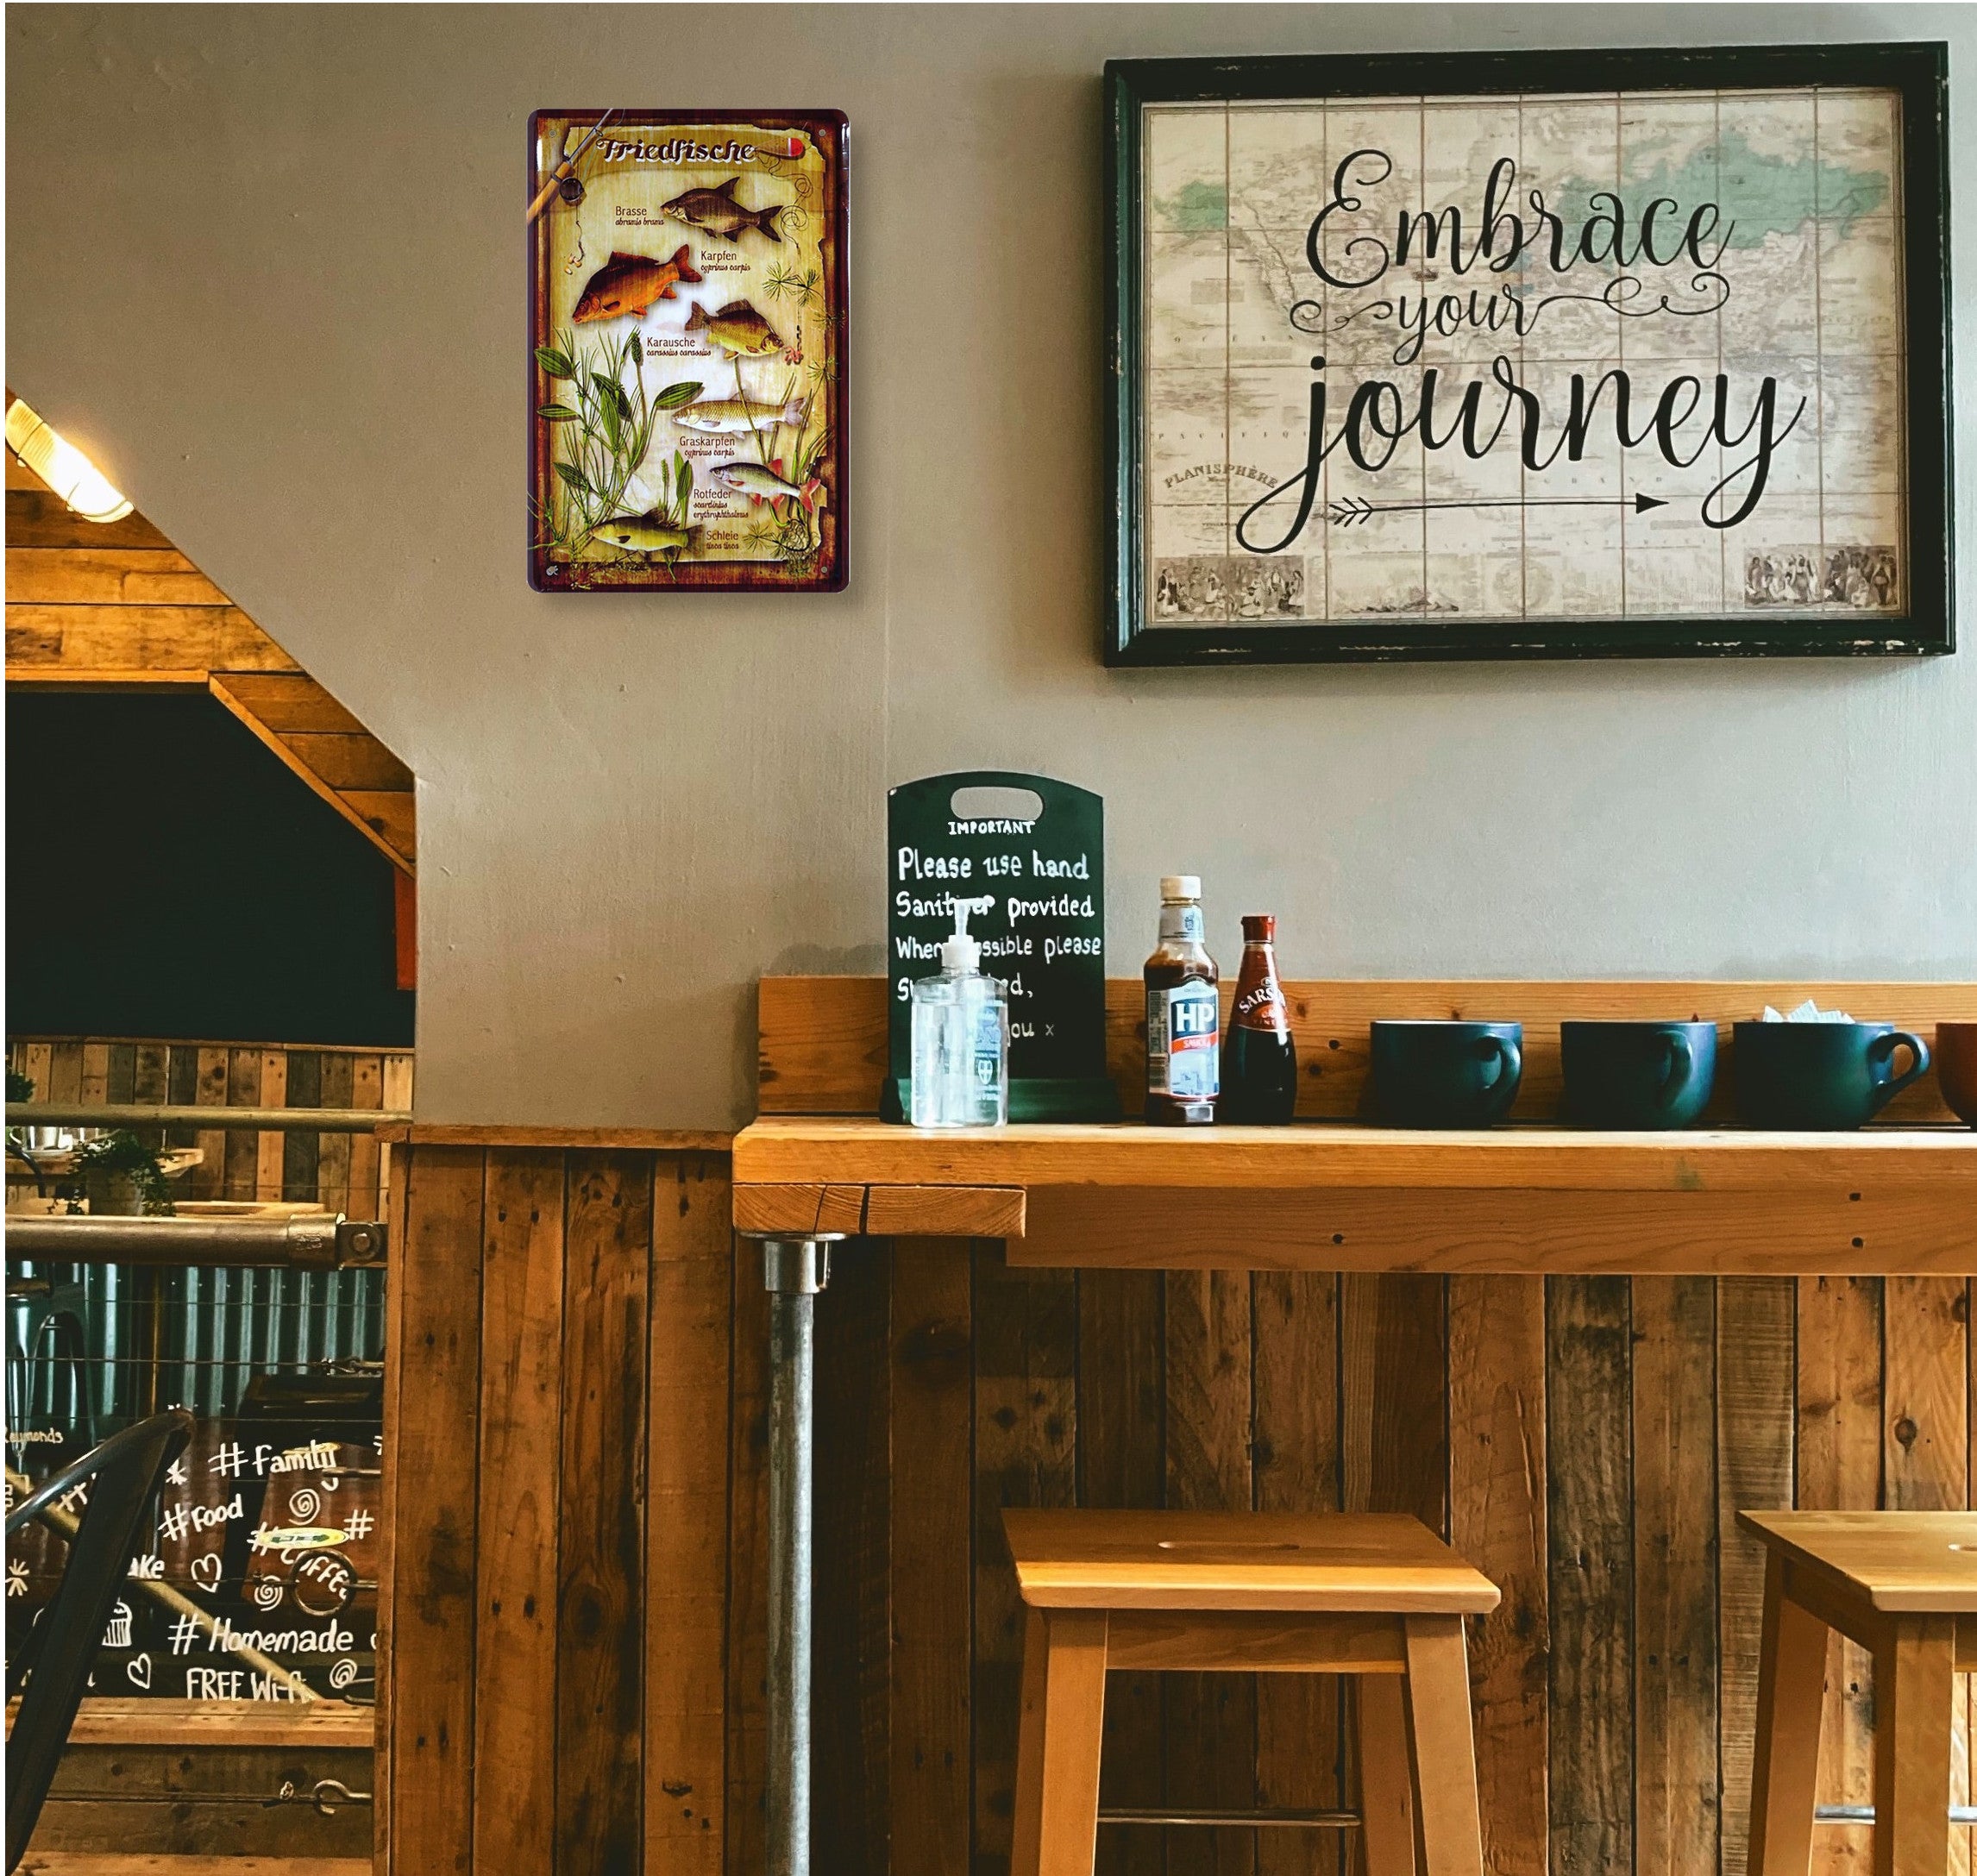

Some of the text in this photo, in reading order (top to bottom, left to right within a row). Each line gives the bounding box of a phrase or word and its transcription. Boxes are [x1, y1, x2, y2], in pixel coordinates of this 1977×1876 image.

[596, 138, 756, 164] Friedfische
[615, 205, 647, 216] Brasse
[1305, 148, 1735, 288] Embrace
[700, 250, 737, 263] Karpfen
[646, 336, 695, 347] Karausche
[679, 436, 735, 449] Graskarpfen
[1236, 354, 1808, 554] journey
[1164, 463, 1279, 489] PLANISPHÈRE
[694, 488, 732, 499] Rotfeder
[706, 530, 739, 540] Schleie
[947, 819, 1036, 836] IMPORTANT
[898, 846, 1089, 881] Please use hand
[1007, 894, 1095, 927] provided
[1044, 935, 1101, 964] please
[1175, 1003, 1215, 1032] HP
[186, 1667, 244, 1701] FREE
